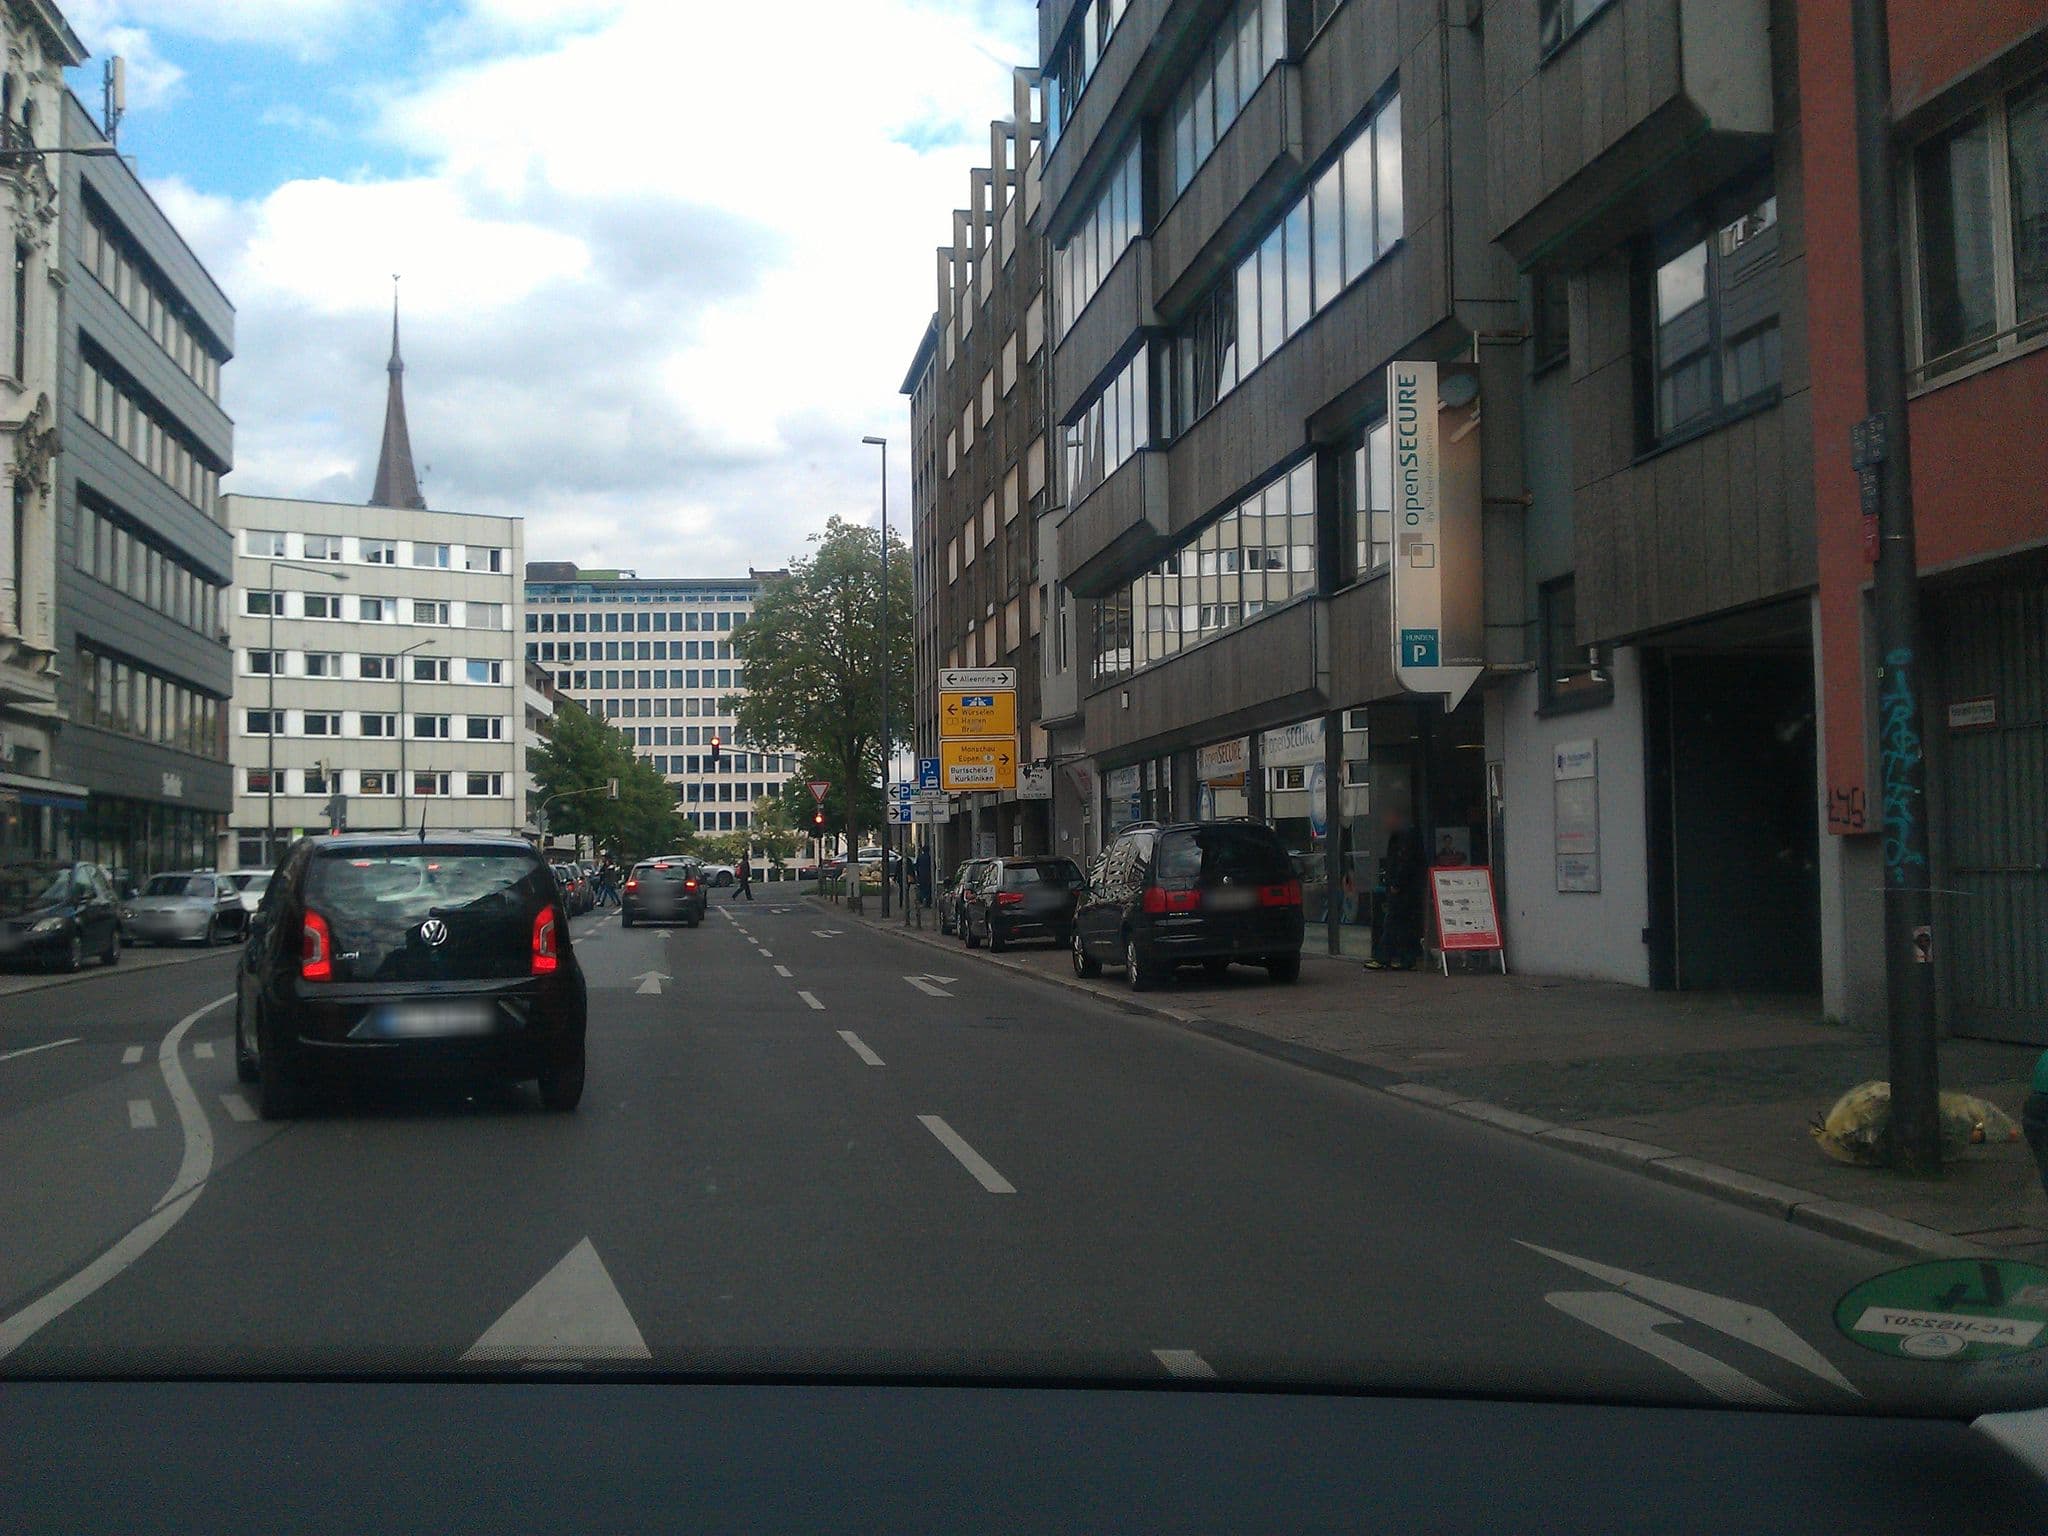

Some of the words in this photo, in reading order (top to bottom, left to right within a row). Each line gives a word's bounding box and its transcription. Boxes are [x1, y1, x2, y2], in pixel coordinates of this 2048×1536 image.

[1398, 373, 1424, 527] openSECURE
[1413, 644, 1427, 663] P
[959, 674, 996, 684] Alleenring
[958, 755, 980, 763] Eupen
[921, 761, 931, 773] P
[950, 766, 988, 774] Burtscheid
[901, 786, 909, 798] P
